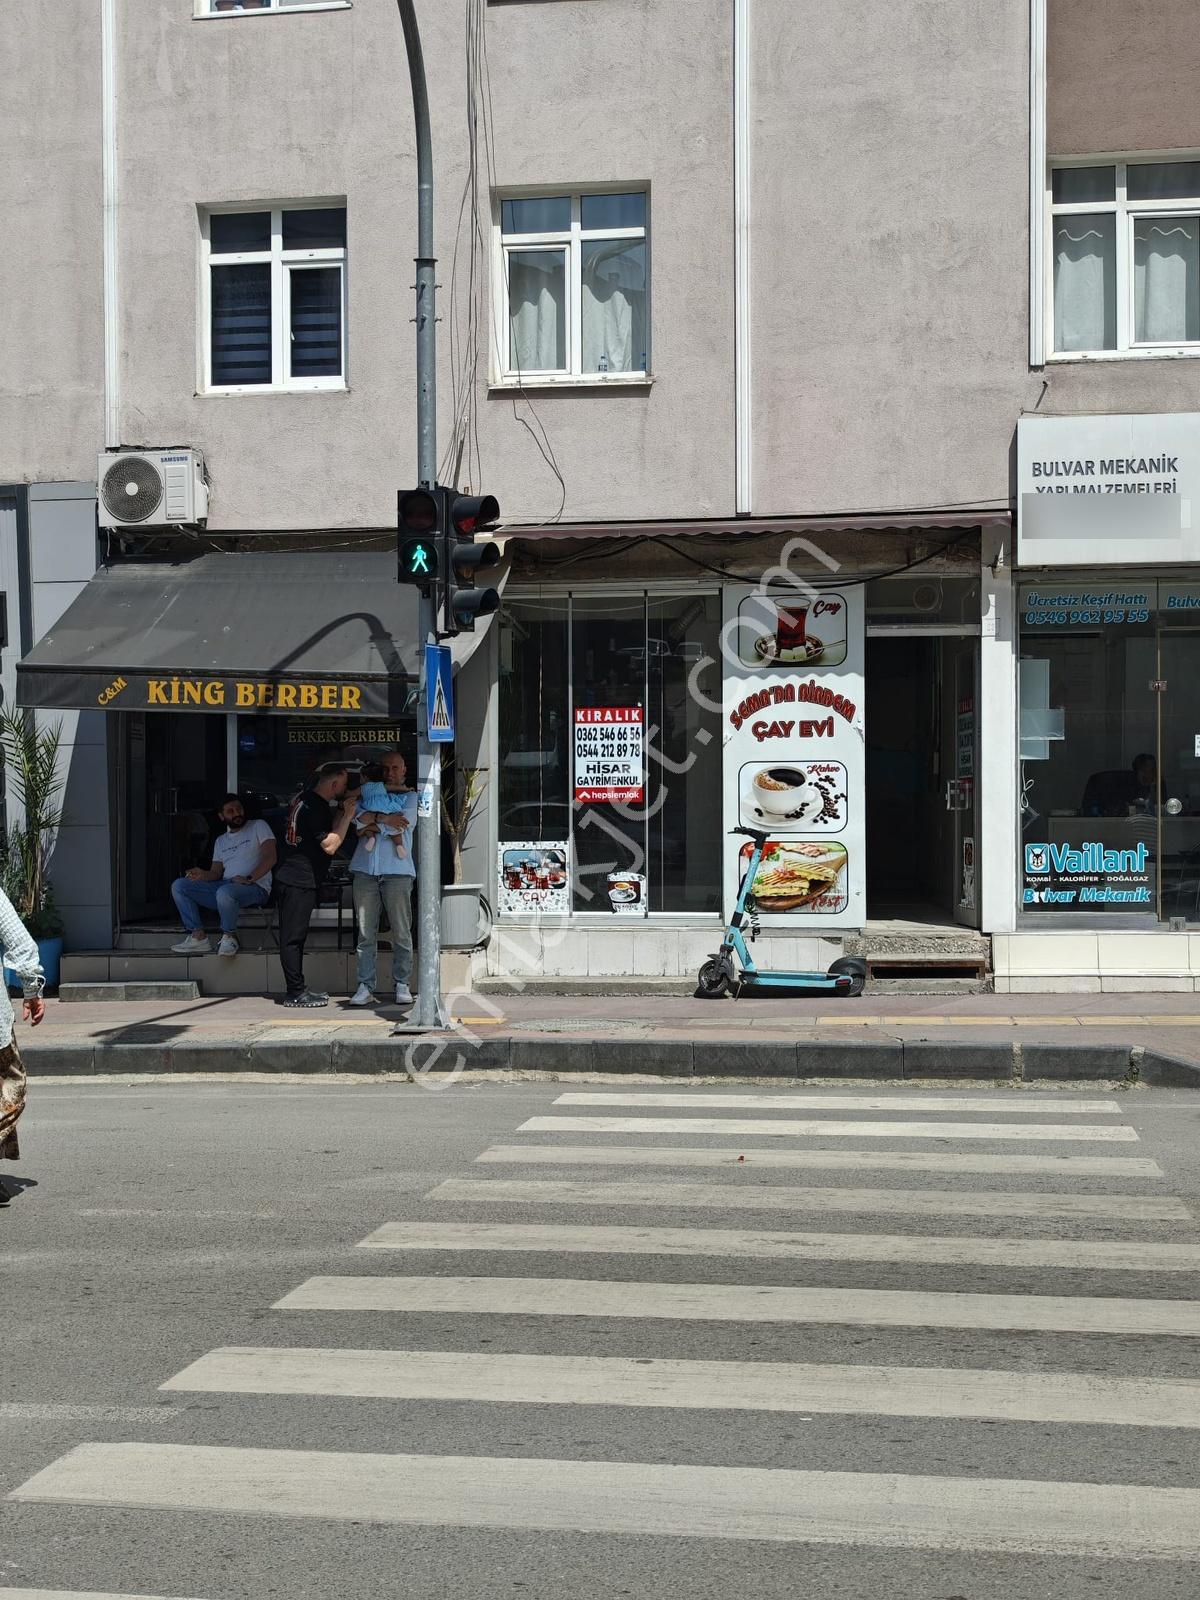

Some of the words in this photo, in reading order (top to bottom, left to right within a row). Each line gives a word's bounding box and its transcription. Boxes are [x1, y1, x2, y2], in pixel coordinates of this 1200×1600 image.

[160, 455, 189, 463] SAMSUNG
[1032, 460, 1095, 477] BULVAR
[1099, 453, 1179, 475] MEKANİK
[1027, 592, 1079, 606] Ücretsiz
[1080, 593, 1113, 608] Keşif
[812, 600, 841, 618] Çay
[1026, 611, 1067, 624] 0546
[1070, 610, 1100, 624] 962
[1103, 609, 1125, 623] 95
[1127, 608, 1149, 623] 55
[98, 677, 128, 705] C&M
[147, 676, 225, 705] KİNG
[235, 683, 361, 709] BERBER
[576, 709, 640, 722] KİRALIK
[288, 730, 338, 743] ERKEK
[339, 728, 401, 743] BERBERİ
[576, 727, 598, 741] 0362
[600, 727, 615, 741] 546
[617, 727, 628, 741] 66
[630, 727, 641, 741] 56
[751, 720, 796, 742] ÇAY
[799, 716, 835, 738] EVİ
[576, 743, 599, 757] 0544
[601, 743, 615, 757] 212
[617, 743, 628, 757] 89
[630, 743, 641, 757] 78
[586, 761, 631, 774] HİSAR
[577, 773, 641, 786] GAYRİMENKUL
[591, 791, 640, 800] hepsiemlak
[1050, 842, 1150, 873] Vaillant
[1026, 875, 1052, 883] KOMBİ
[1107, 874, 1149, 882] DOĞALGAZ
[1078, 886, 1151, 903] Mekanik
